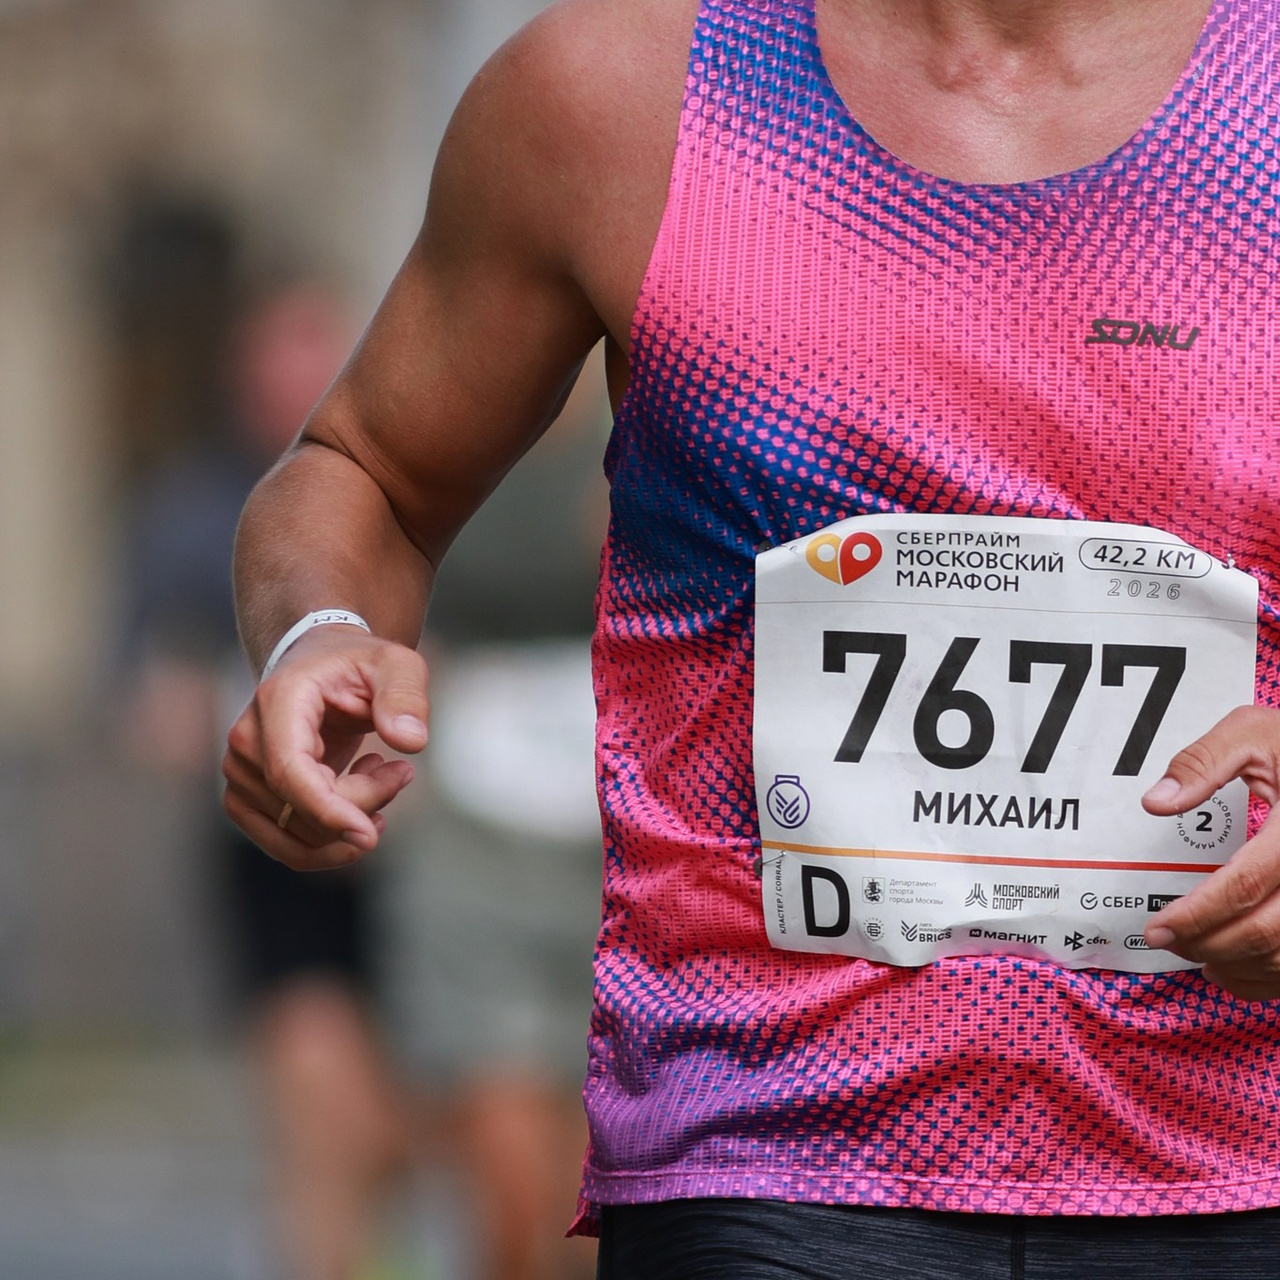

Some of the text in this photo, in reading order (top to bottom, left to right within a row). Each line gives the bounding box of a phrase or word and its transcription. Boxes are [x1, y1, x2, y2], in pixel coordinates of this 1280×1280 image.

[896, 531, 1020, 548] СБЕРПРАЙМ
[896, 549, 1064, 573] МОСКОВСКИЙ
[1093, 545, 1147, 567] 42,2
[896, 570, 1019, 593] МАРАФОН
[1107, 578, 1181, 600] 2026
[823, 630, 1187, 777] 7677
[912, 790, 1080, 831] МИХАИЛ
[1196, 811, 1212, 832] 2
[801, 864, 850, 938] D
[992, 883, 1060, 900] МОСКОВСКИЙ
[1103, 896, 1144, 908] СБЕР
[992, 897, 1024, 911] СПОРТ
[919, 931, 952, 943] BRICS
